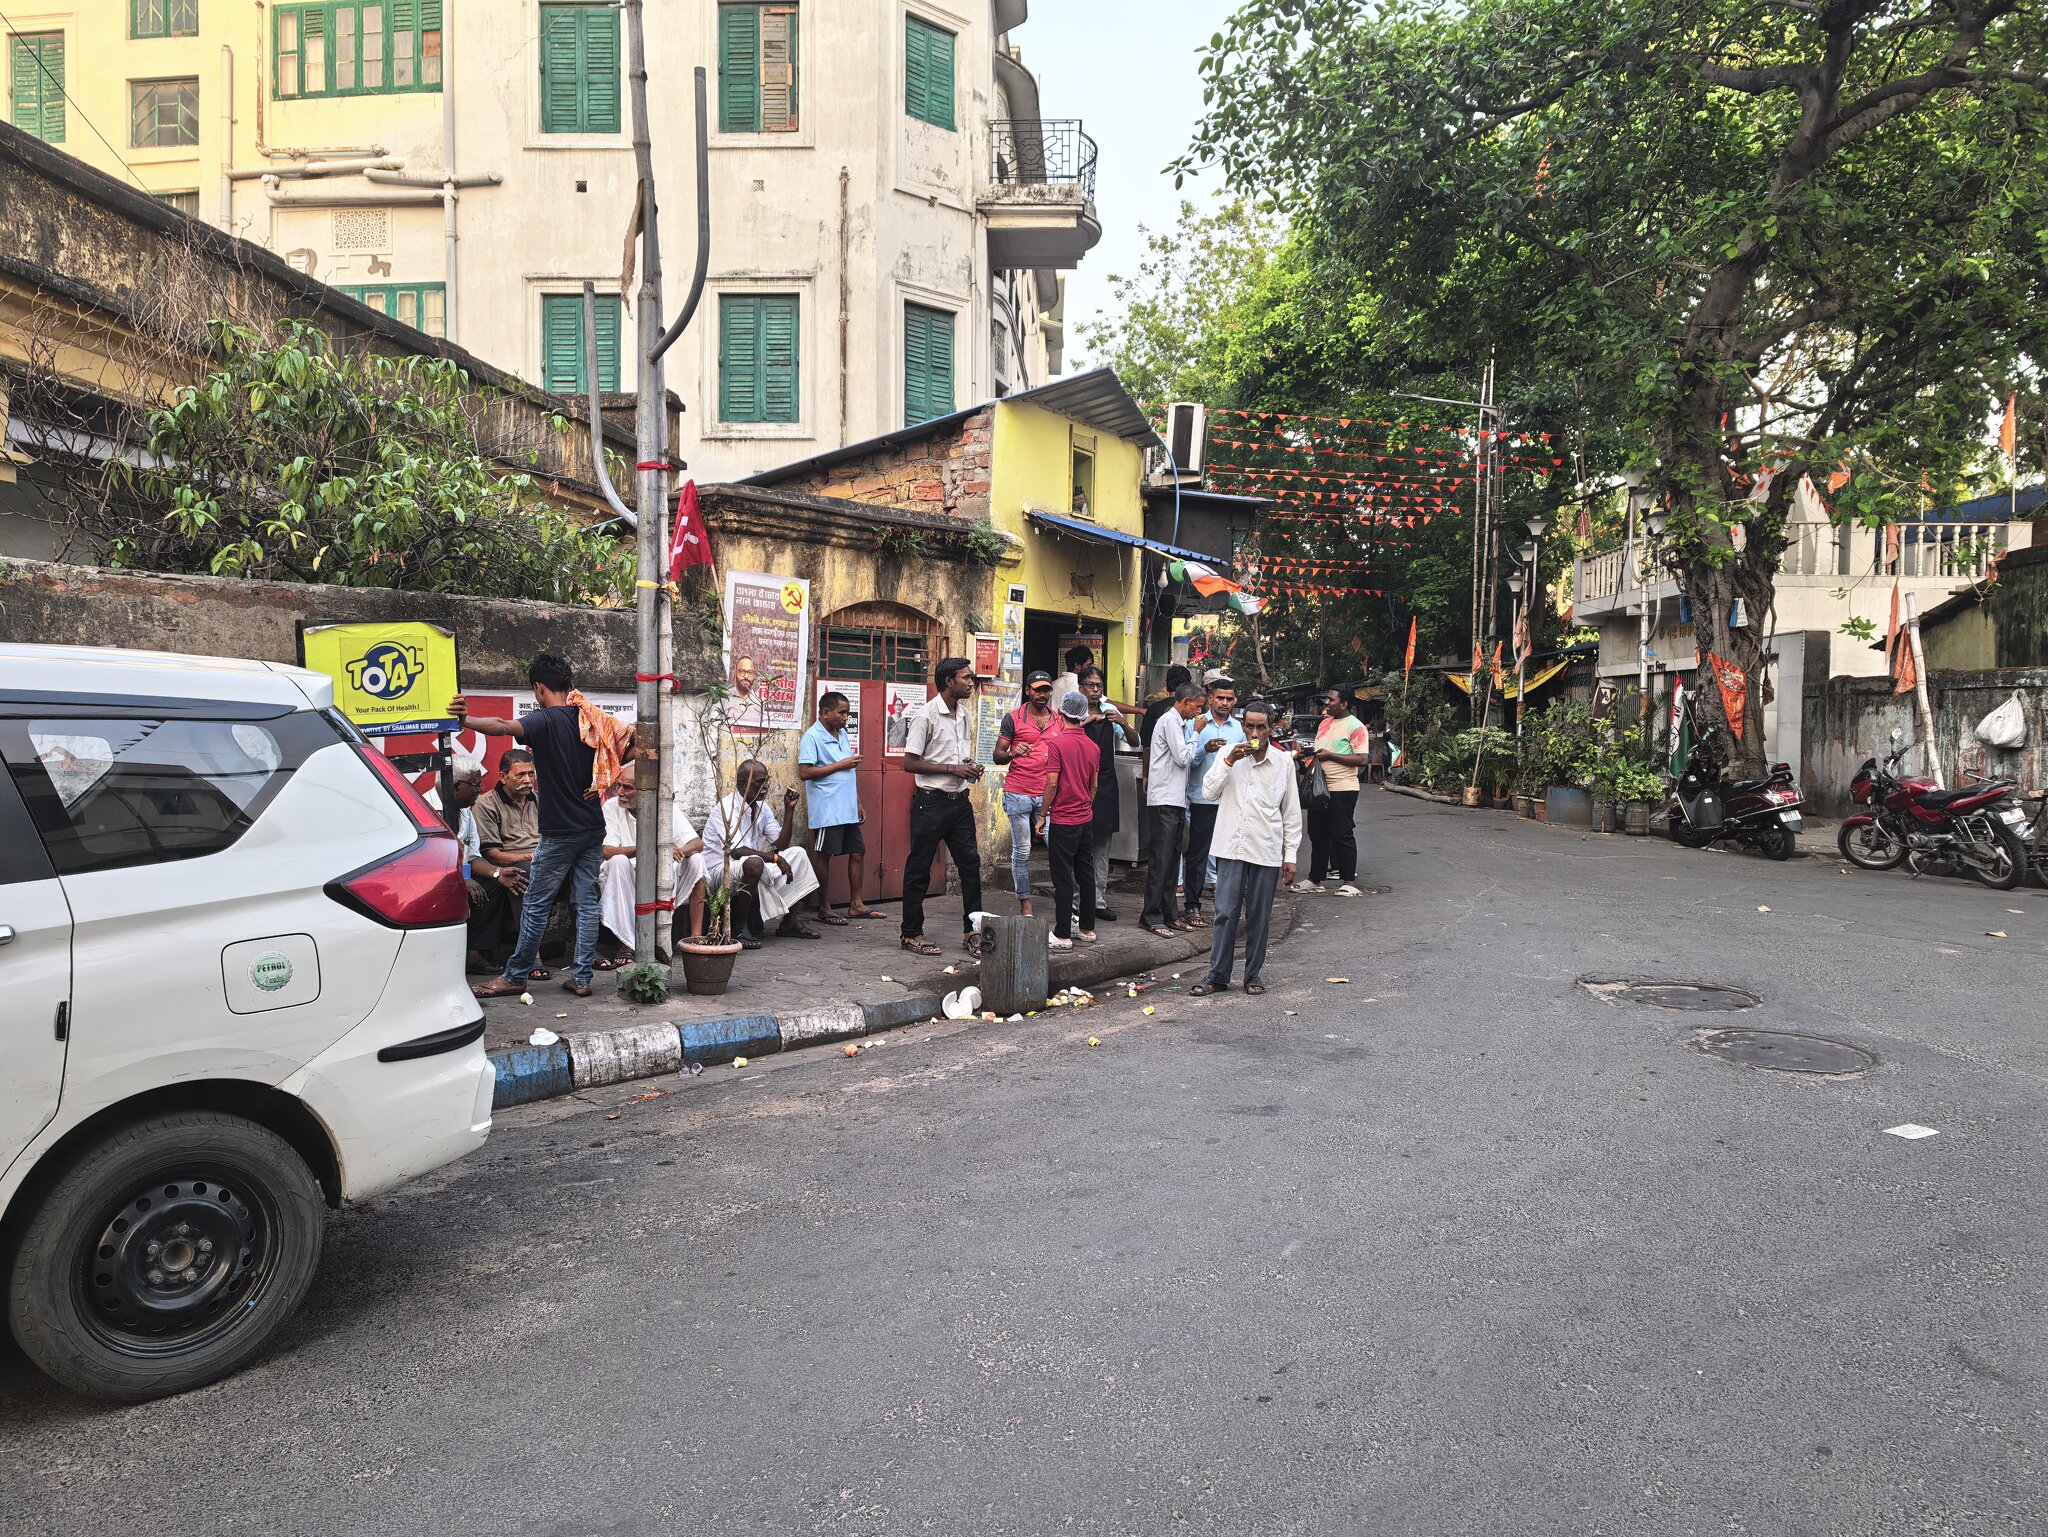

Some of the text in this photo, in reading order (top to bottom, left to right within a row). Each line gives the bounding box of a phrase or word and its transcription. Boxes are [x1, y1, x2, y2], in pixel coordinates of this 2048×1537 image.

[736, 586, 757, 597] বাংলা
[735, 596, 751, 606] লাল
[346, 646, 424, 693] TOTAL
[392, 723, 420, 731] SHALIMAR
[420, 722, 439, 730] GROUP
[256, 961, 286, 973] PETROL
